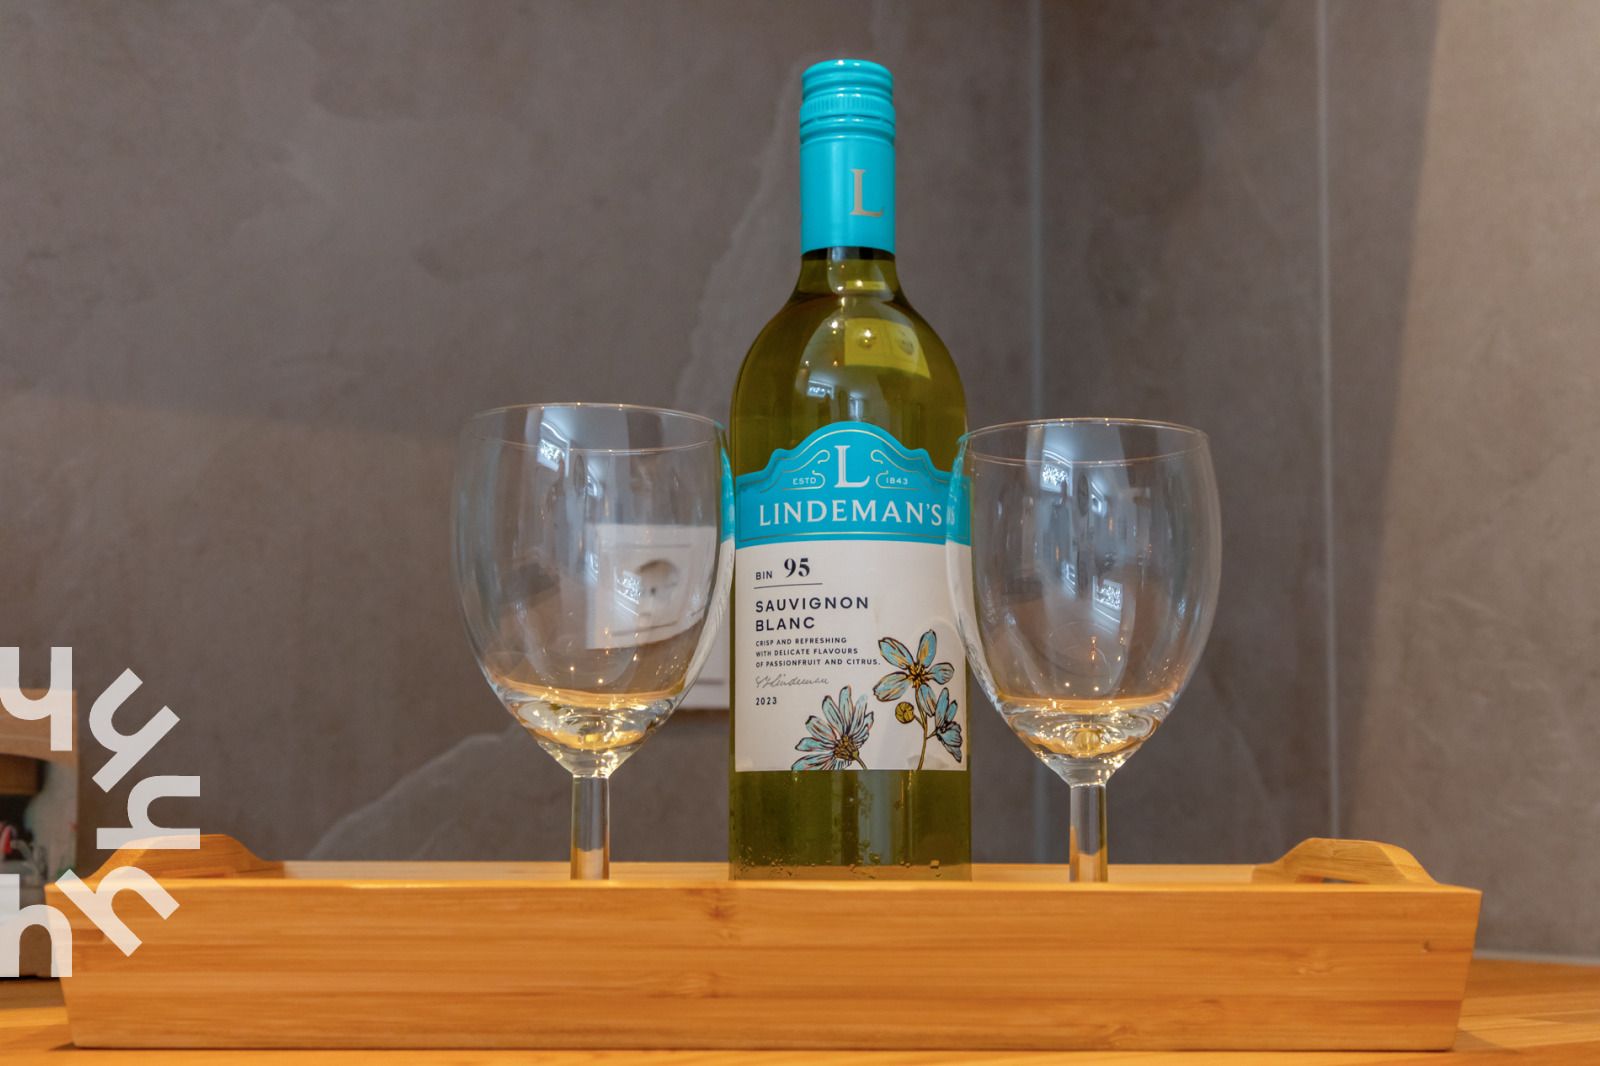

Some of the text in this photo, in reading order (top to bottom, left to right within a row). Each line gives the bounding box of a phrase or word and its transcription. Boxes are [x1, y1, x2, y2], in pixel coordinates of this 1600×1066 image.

[849, 168, 883, 218] L
[834, 444, 871, 488] L
[792, 476, 817, 486] ESTD
[885, 476, 909, 486] 1843
[759, 499, 942, 527] LINDEMAN'S
[755, 557, 811, 581] BIN 95
[755, 596, 869, 613] SAUVIGNON
[755, 616, 816, 632] BLANC
[755, 637, 847, 647] CRISP AND REFRESHING
[755, 647, 859, 658] WITH DELICATE FLAVOURS
[755, 661, 764, 669] OF
[765, 659, 821, 668] PASSIONFRUIT
[824, 658, 843, 666] AND
[755, 696, 777, 706] 2023
